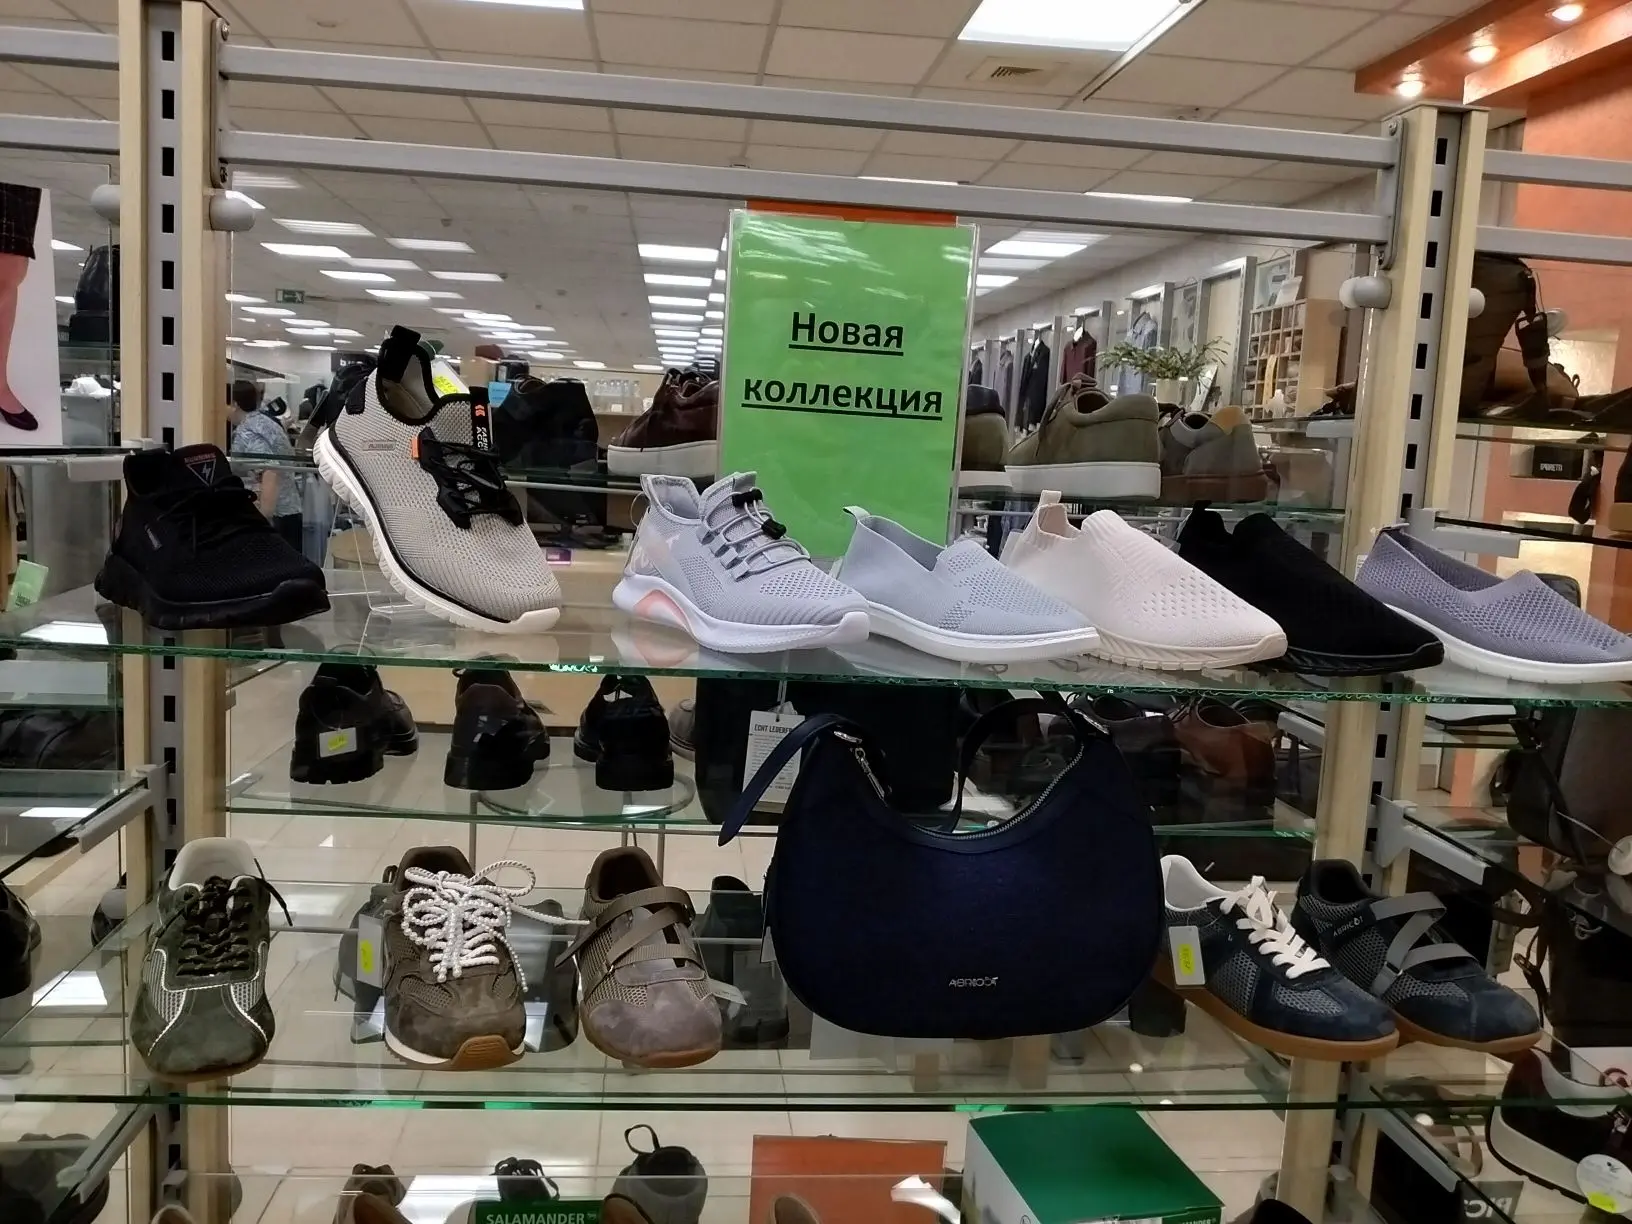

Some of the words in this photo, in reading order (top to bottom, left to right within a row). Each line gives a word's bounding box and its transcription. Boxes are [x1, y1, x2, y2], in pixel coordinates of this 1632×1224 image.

[790, 311, 904, 349] Новая
[743, 378, 944, 416] коллекция
[486, 1213, 585, 1224] SALAMANDER
